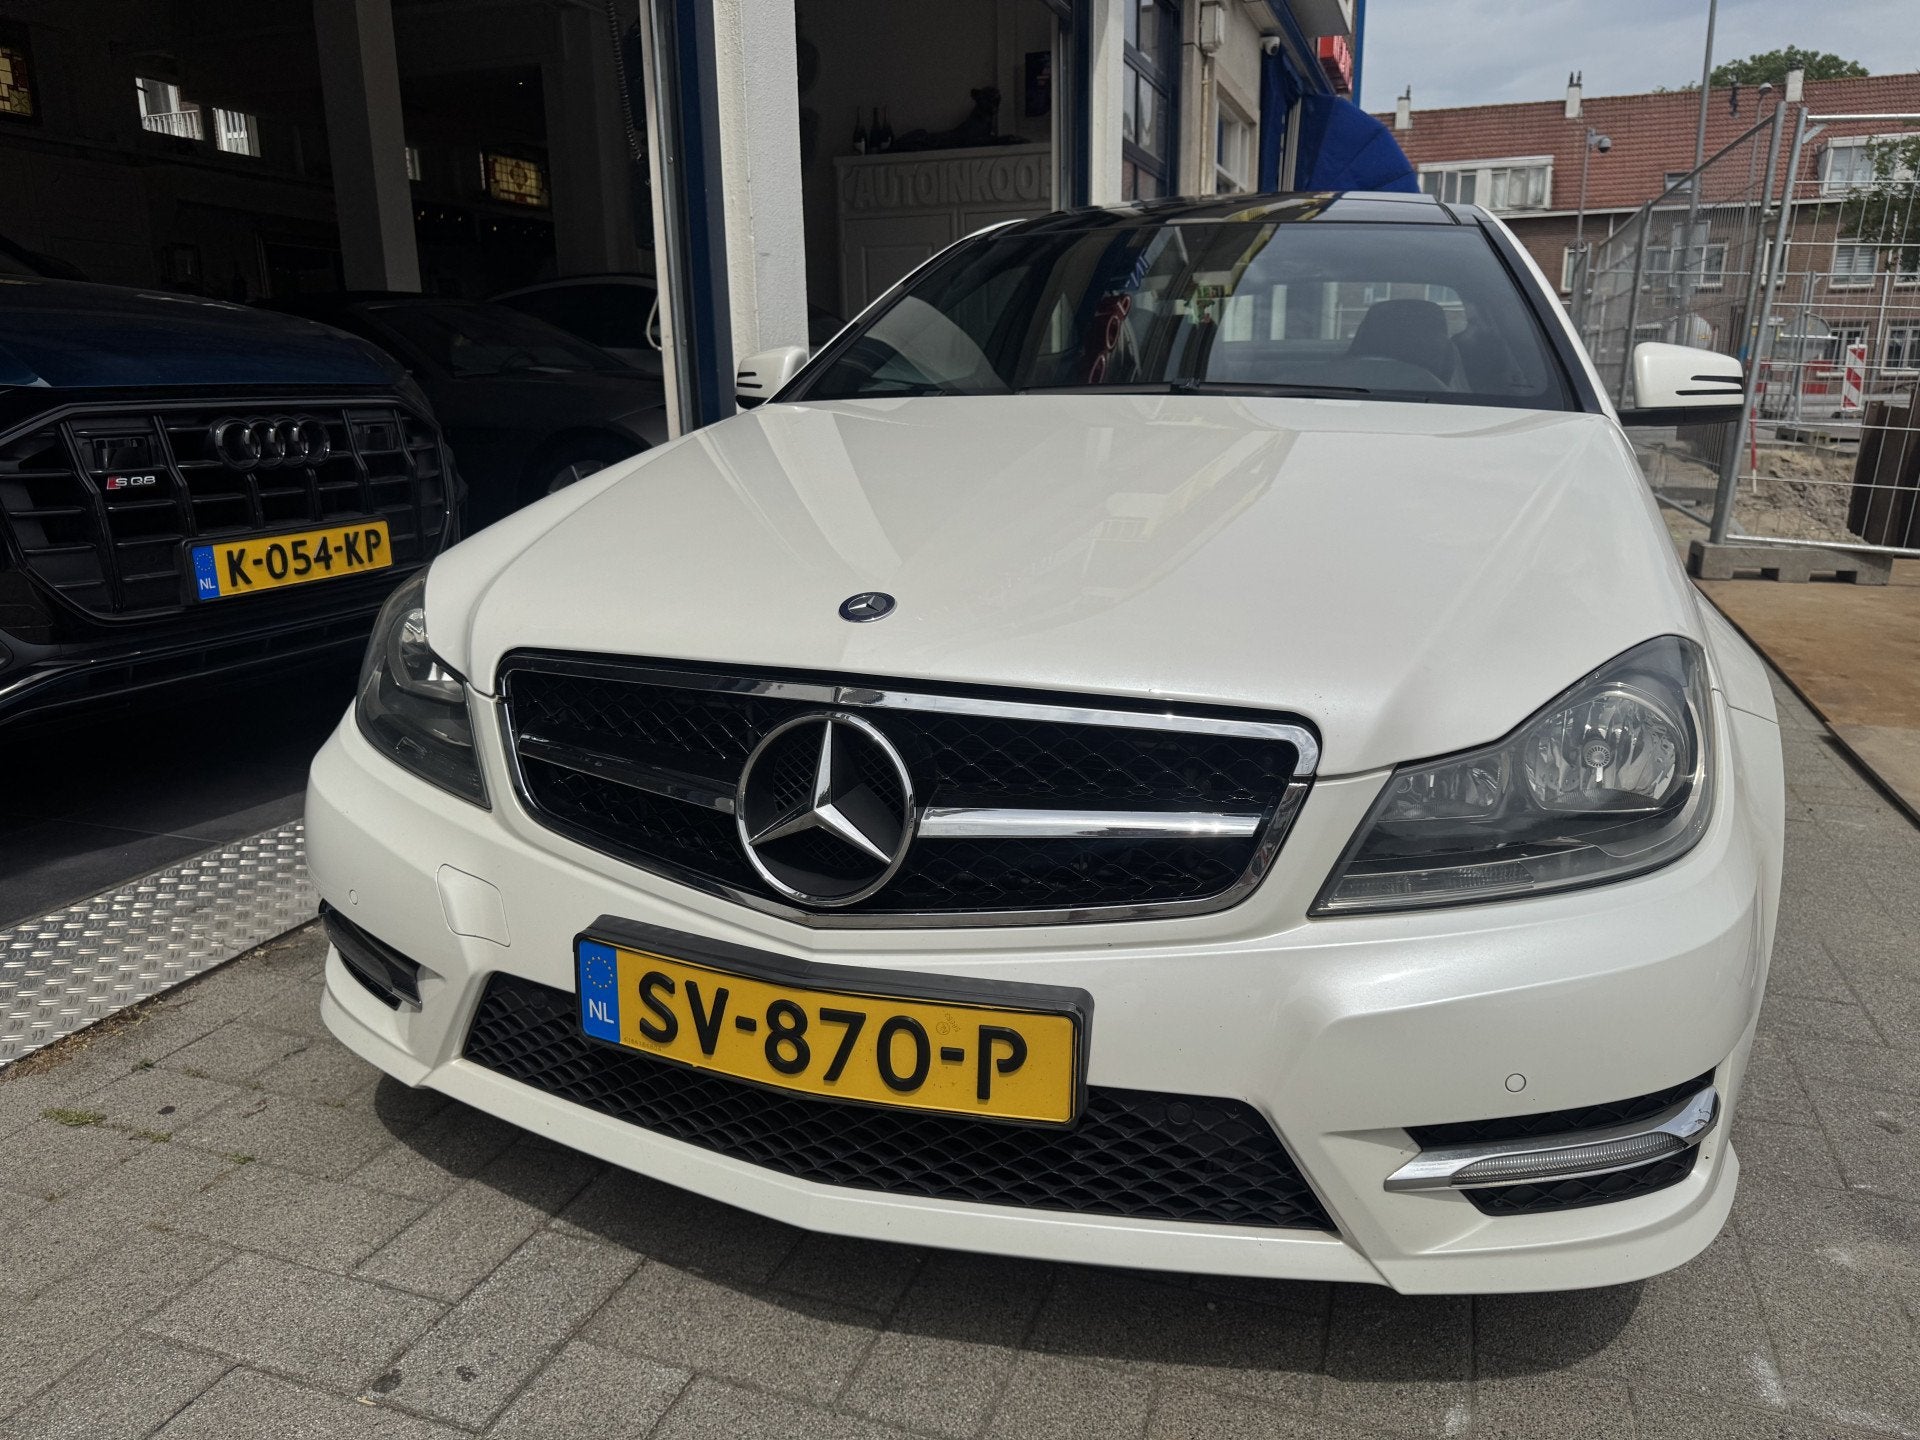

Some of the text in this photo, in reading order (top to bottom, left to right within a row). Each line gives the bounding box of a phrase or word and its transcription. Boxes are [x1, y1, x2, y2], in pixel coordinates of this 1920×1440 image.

[200, 529, 382, 590] NL K-054-KP
[588, 970, 1028, 1100] NL SV-870-P
